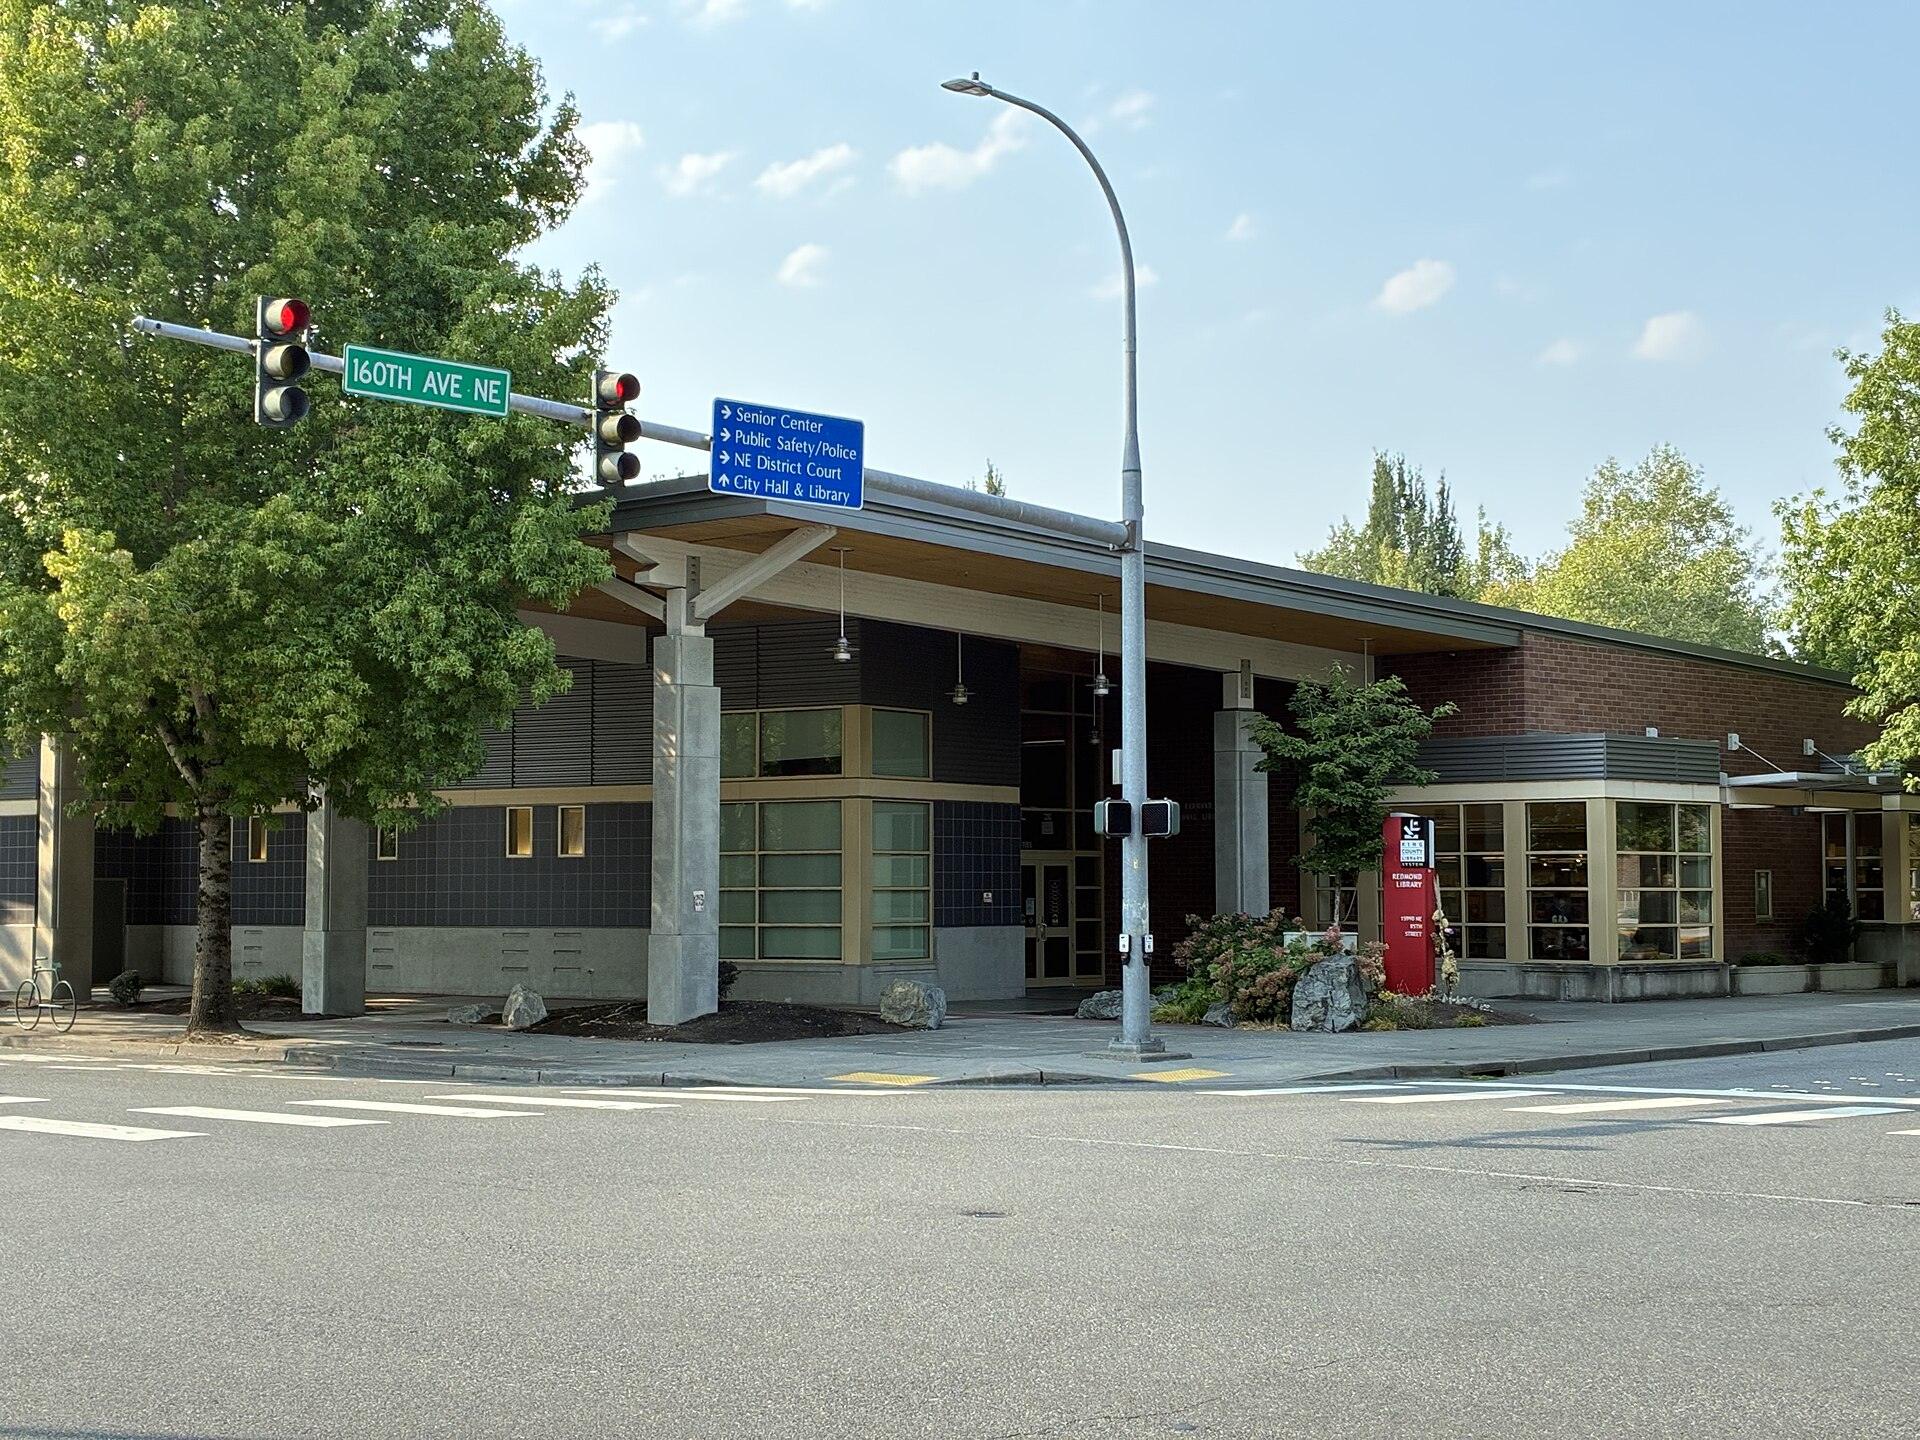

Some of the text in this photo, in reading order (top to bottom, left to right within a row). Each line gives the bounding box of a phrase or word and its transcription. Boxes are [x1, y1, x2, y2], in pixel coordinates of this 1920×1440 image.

[352, 357, 501, 404] 160TH AVE NE
[736, 407, 823, 434] Senior Center
[735, 429, 857, 461] Public Safety/Police
[734, 452, 842, 481] NE District Court
[734, 474, 850, 506] City Hall & Library
